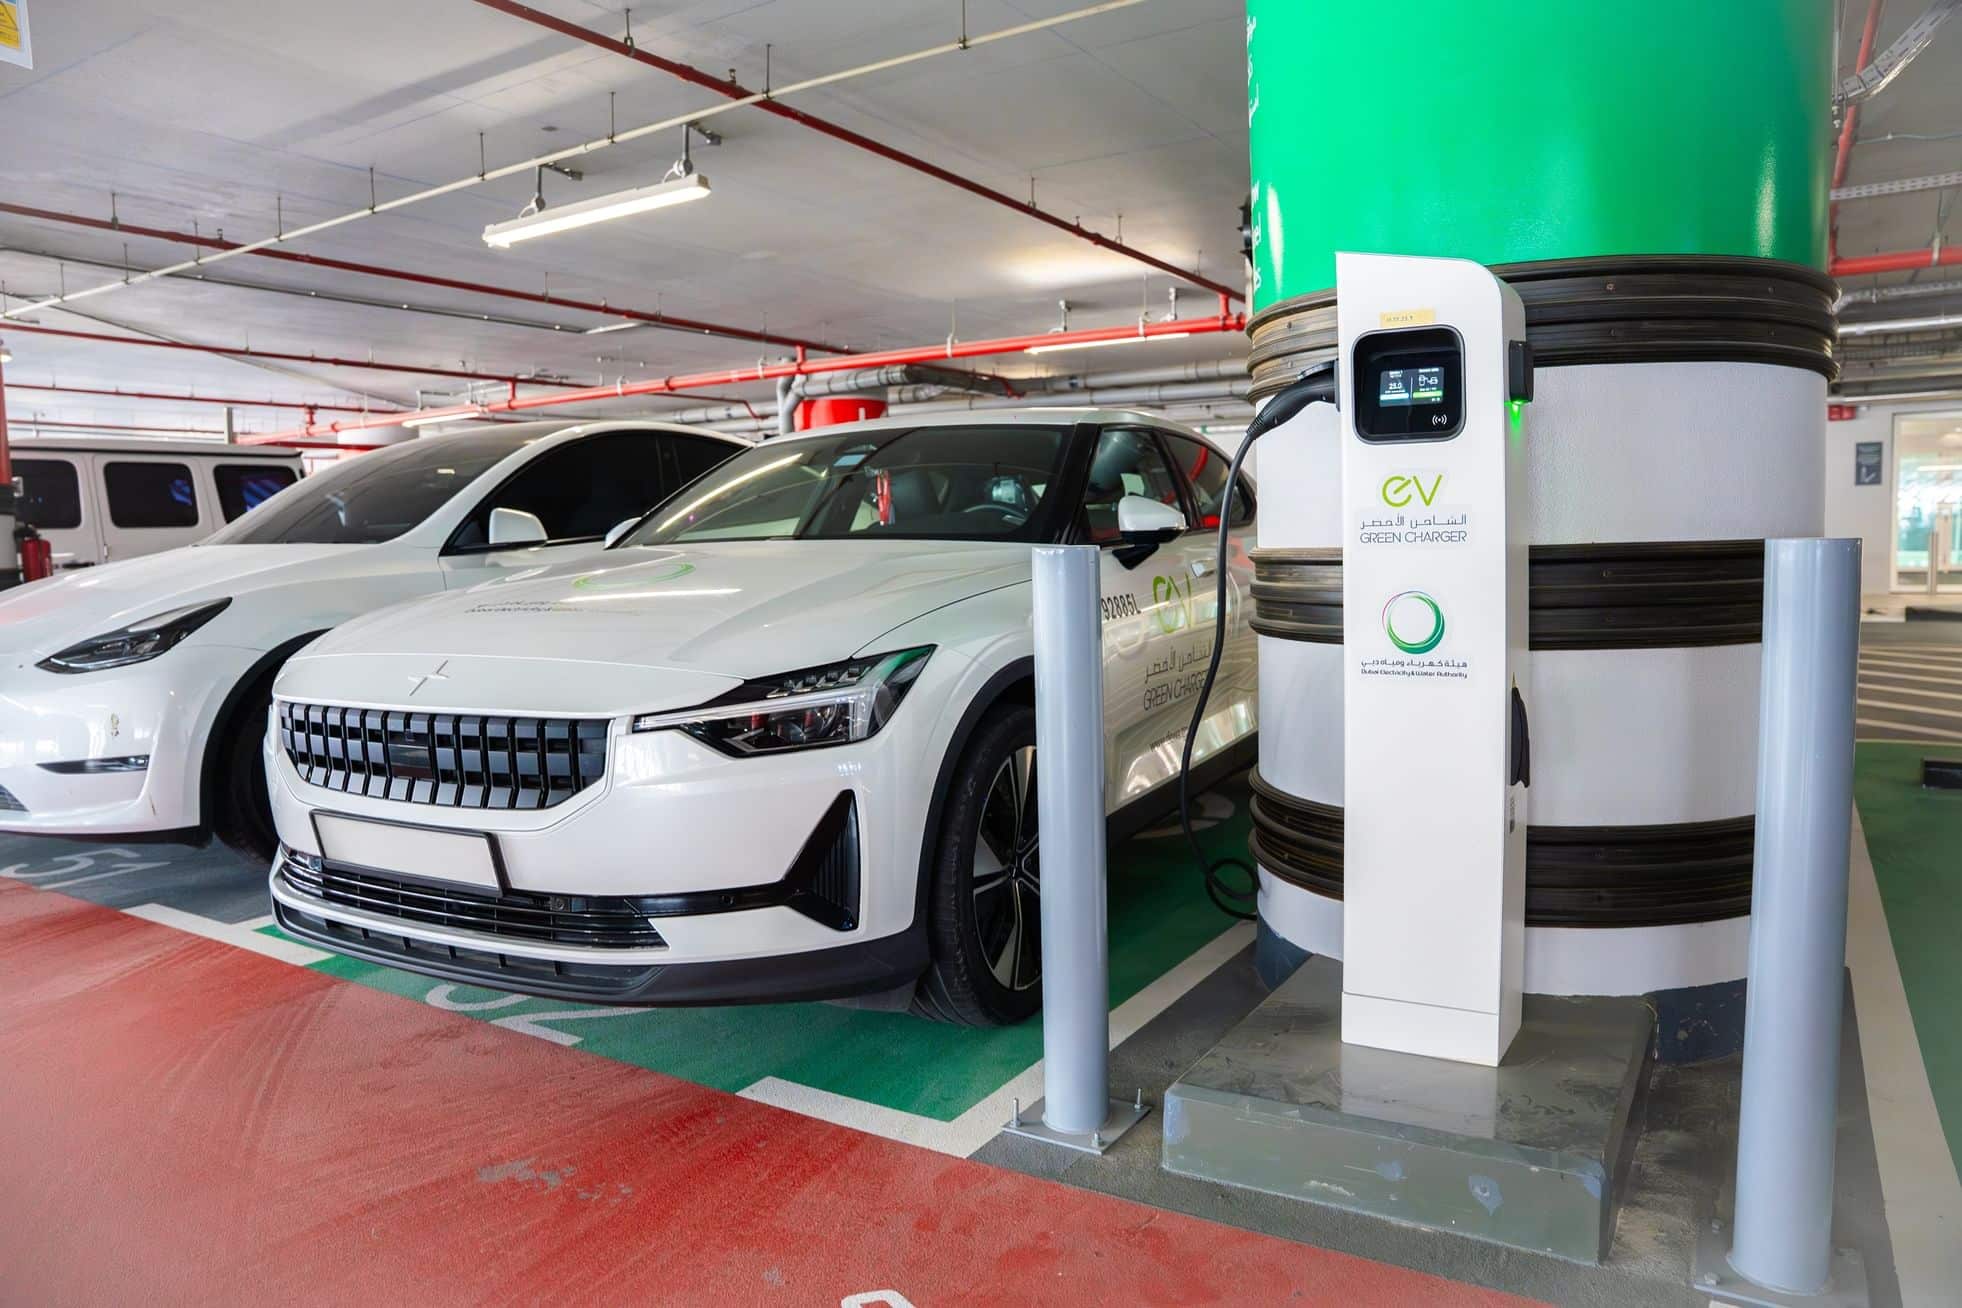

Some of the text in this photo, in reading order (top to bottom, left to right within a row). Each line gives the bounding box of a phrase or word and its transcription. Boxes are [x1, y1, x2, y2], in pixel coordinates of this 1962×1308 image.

[1360, 530, 1468, 544] GREEN CHARGER
[1143, 669, 1208, 711] GREEN CHARGE
